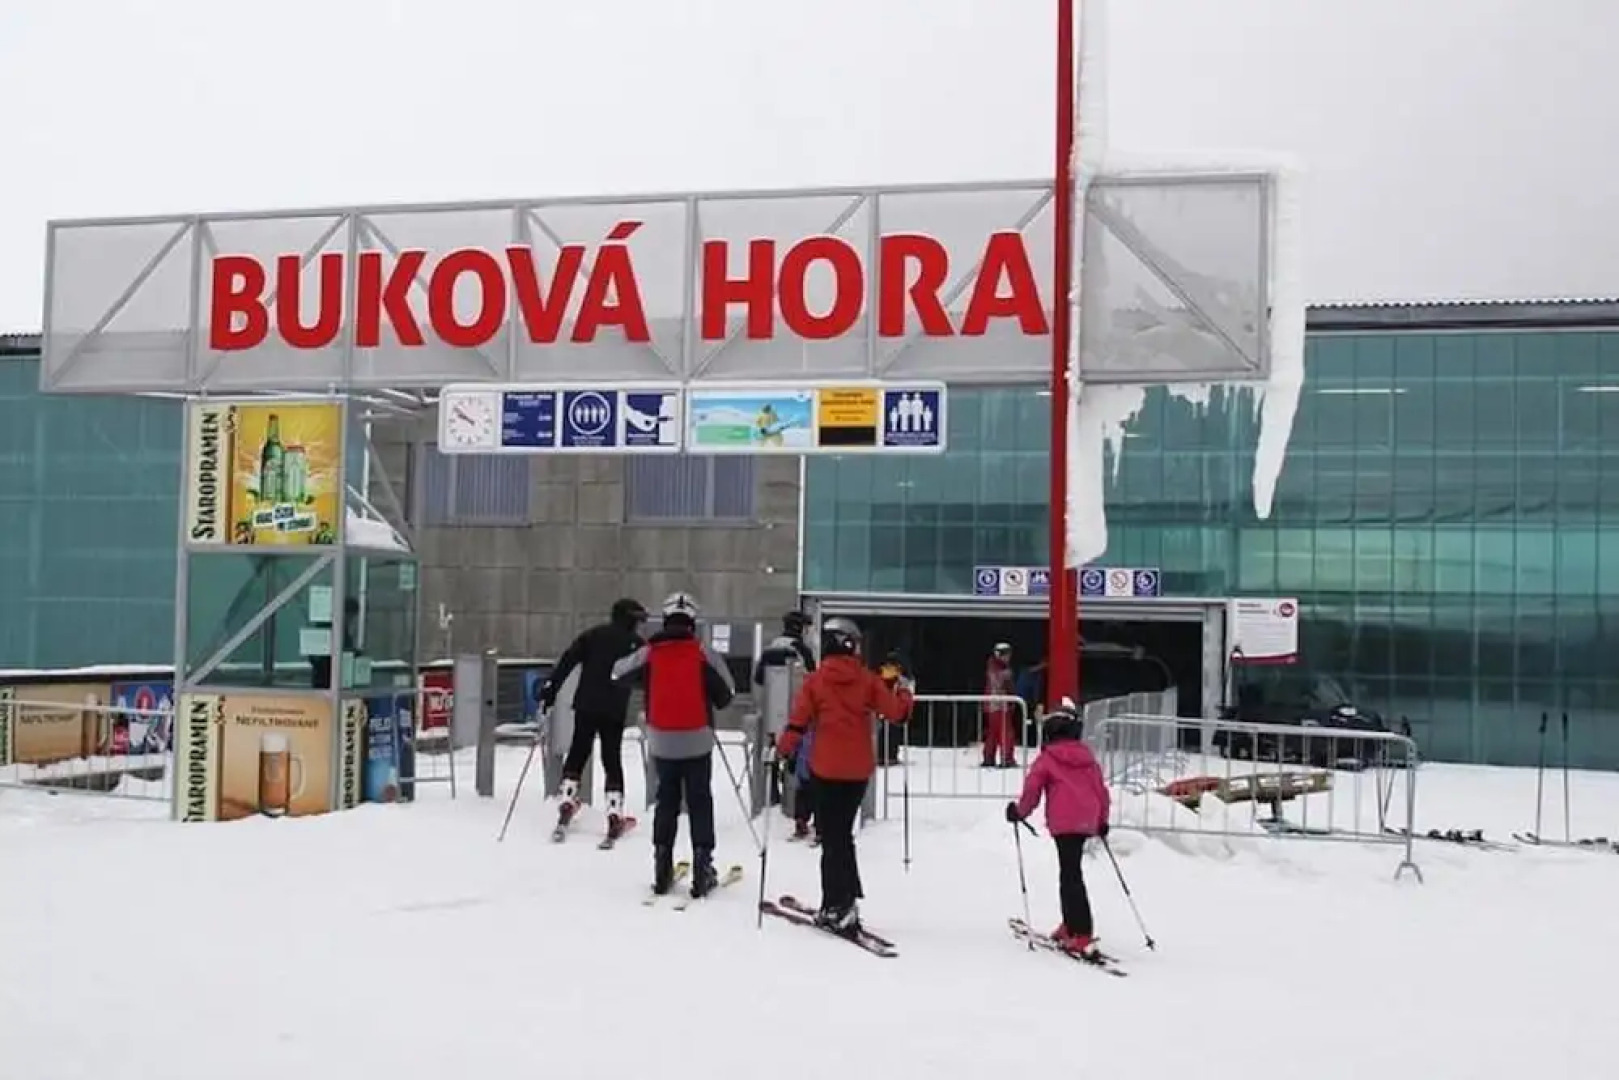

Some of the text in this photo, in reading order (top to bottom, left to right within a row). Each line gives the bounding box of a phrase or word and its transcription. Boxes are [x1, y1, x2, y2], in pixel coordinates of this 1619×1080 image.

[209, 221, 1050, 351] BUKOVÁ HORA
[192, 412, 218, 539] STAROPRAMEN
